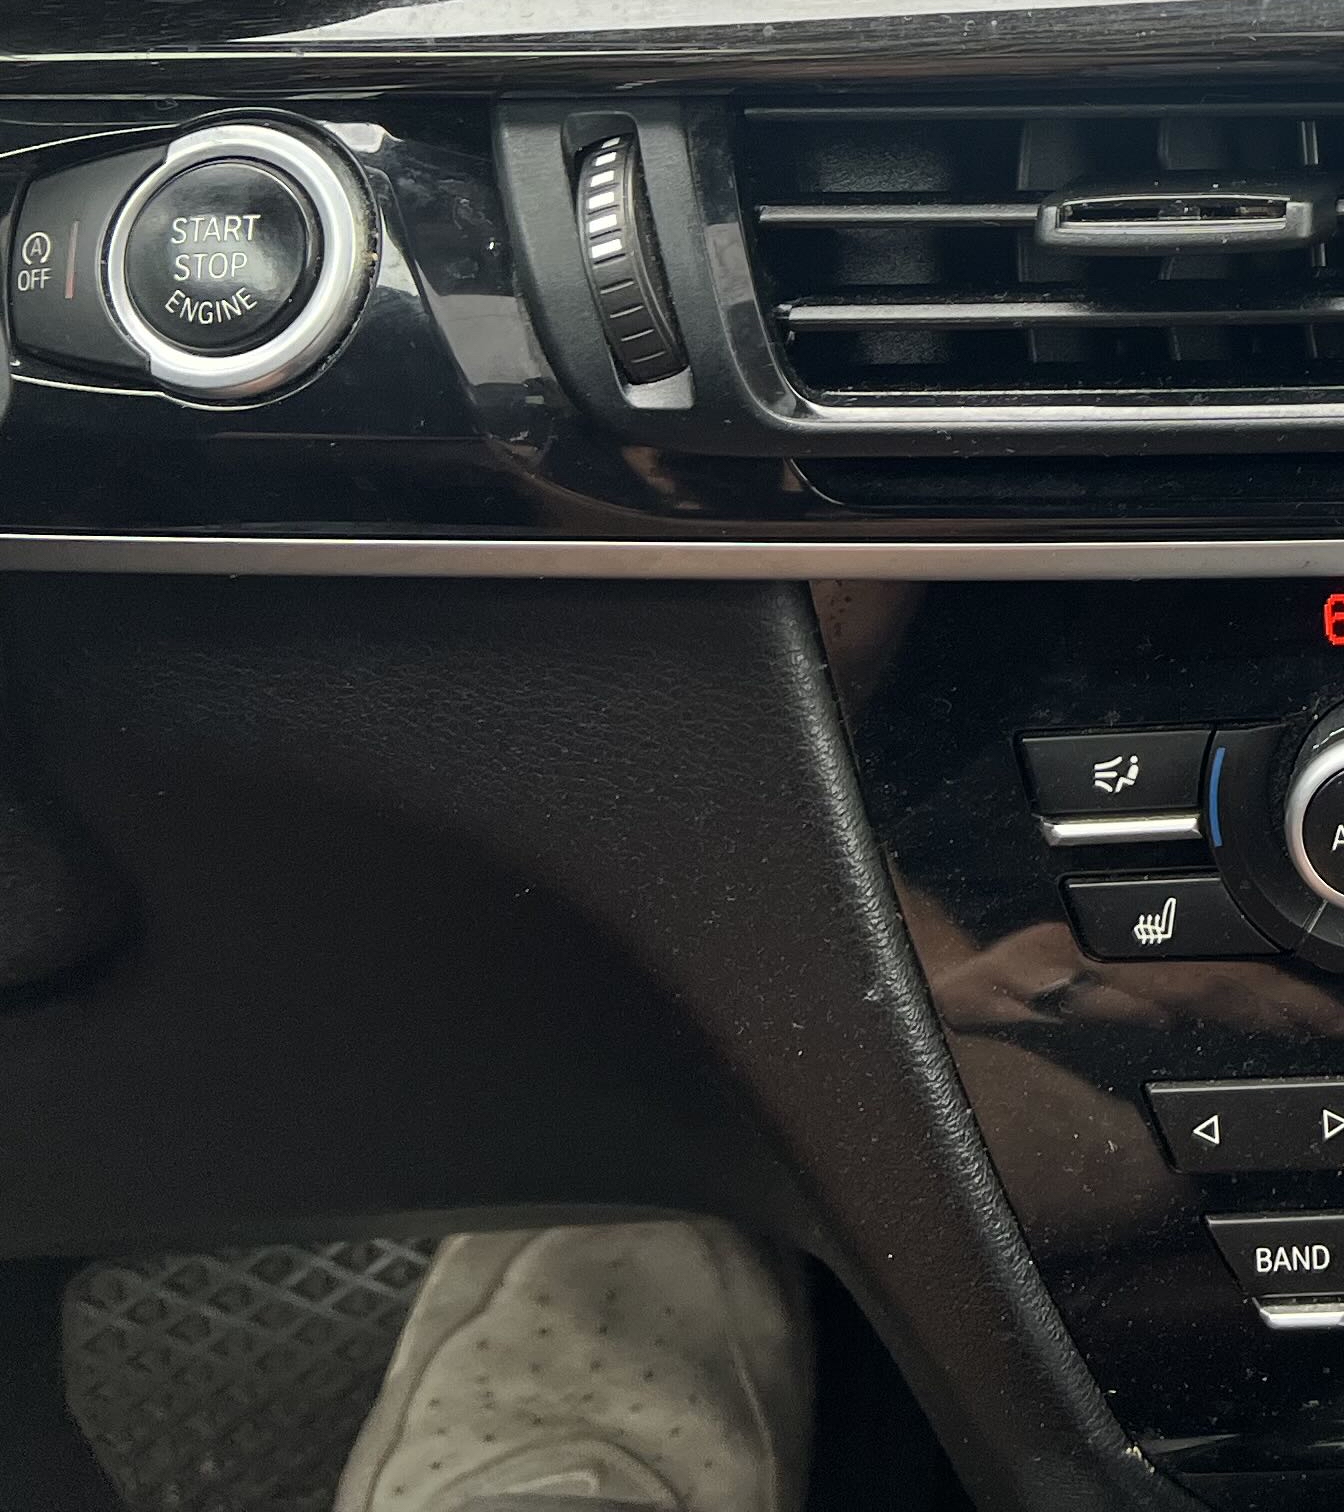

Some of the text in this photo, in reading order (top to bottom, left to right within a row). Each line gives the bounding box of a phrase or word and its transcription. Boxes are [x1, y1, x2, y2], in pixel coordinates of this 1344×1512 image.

[171, 214, 261, 245] START
[18, 268, 52, 291] OFF
[173, 252, 248, 281] STOP
[164, 287, 258, 325] ENGINE
[1255, 1245, 1330, 1272] BAND
